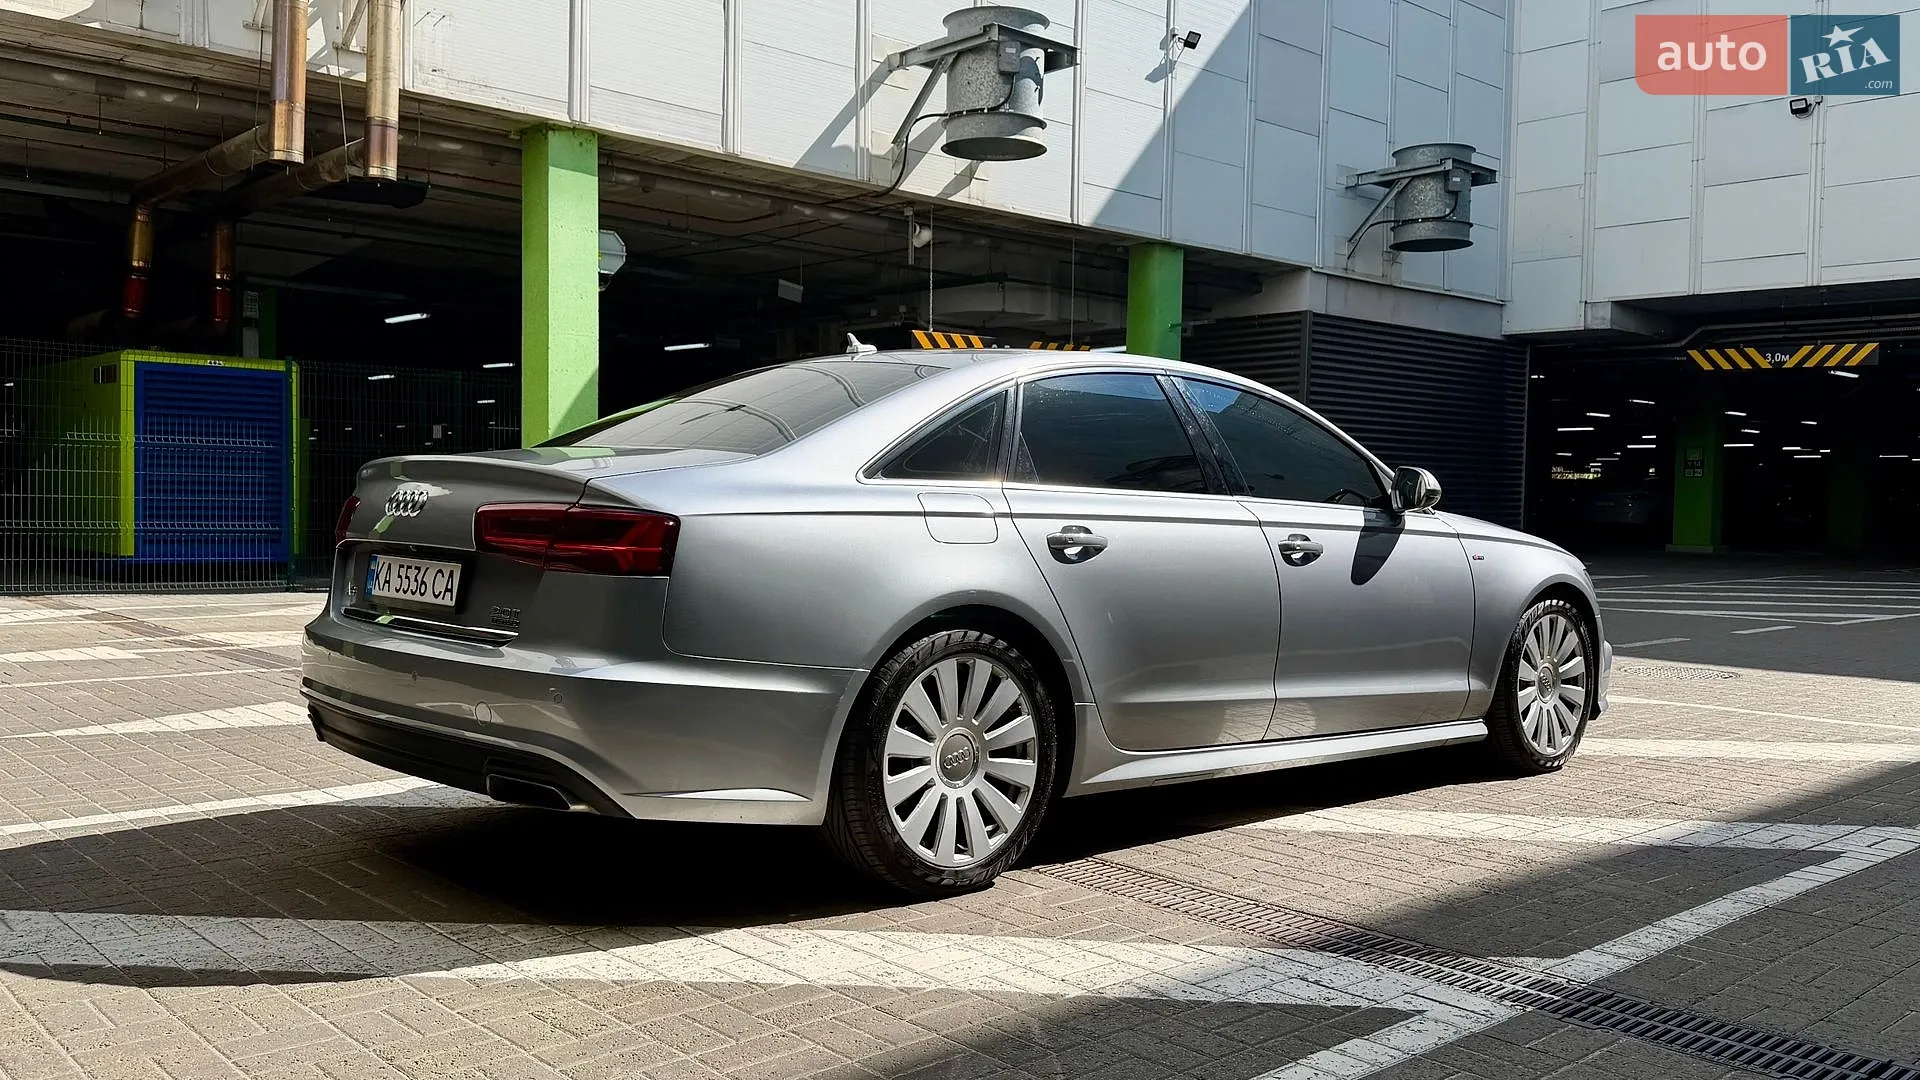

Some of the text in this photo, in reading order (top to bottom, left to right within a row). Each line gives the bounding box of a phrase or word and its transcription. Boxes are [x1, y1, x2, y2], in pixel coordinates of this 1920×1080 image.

[373, 561, 392, 593] KA
[395, 563, 429, 597] 5536
[431, 568, 454, 602] CA
